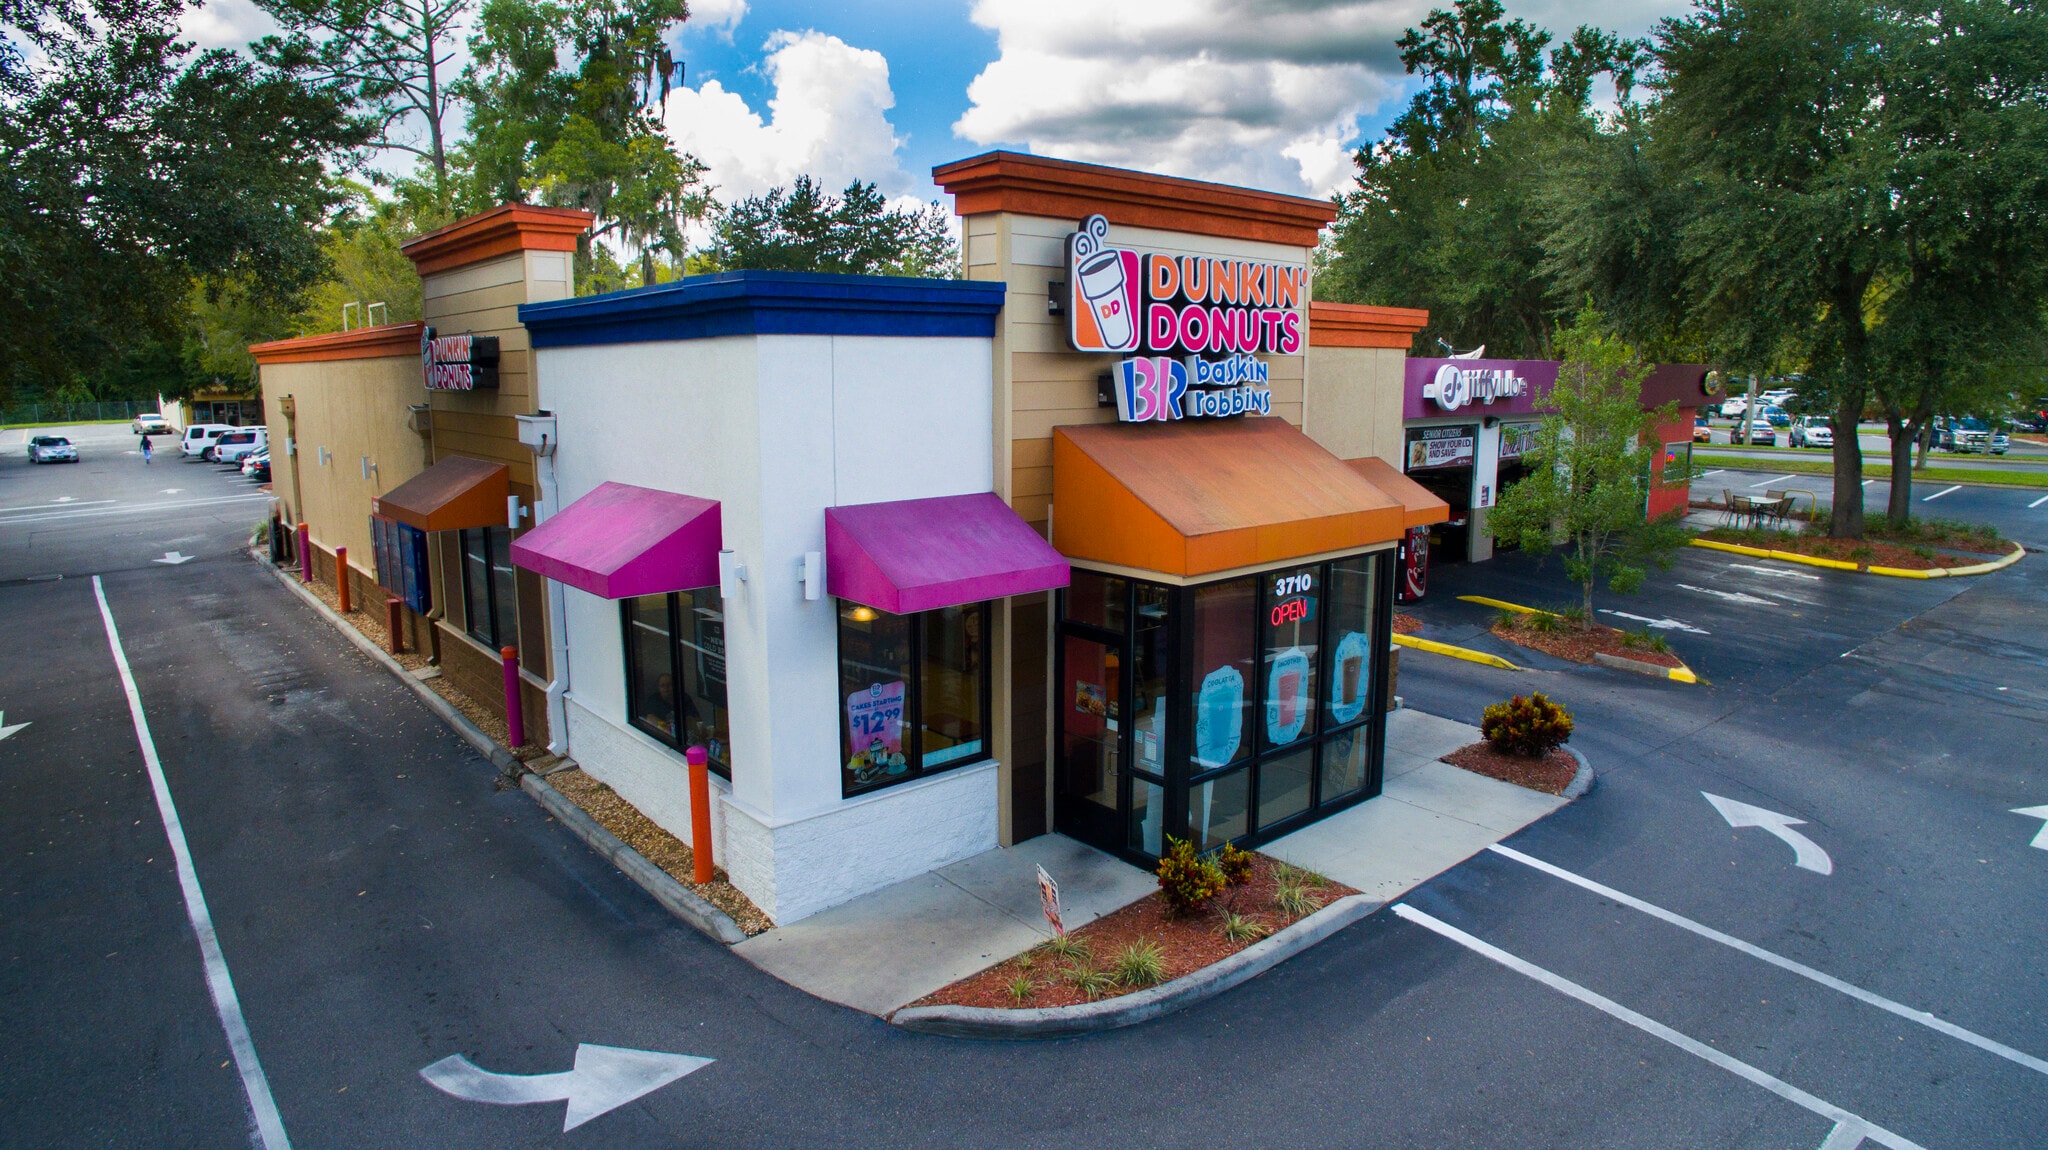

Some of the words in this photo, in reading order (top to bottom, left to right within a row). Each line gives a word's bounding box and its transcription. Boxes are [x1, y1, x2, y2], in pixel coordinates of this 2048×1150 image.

[1150, 254, 1308, 308] DUNKIN'
[1100, 300, 1120, 319] DD
[1149, 303, 1300, 353] DONUTS
[435, 363, 473, 390] DONUTS
[1194, 354, 1268, 386] baskin
[1121, 356, 1188, 421] BR
[1464, 369, 1497, 405] jiffy
[1497, 369, 1527, 397] lube
[1194, 387, 1271, 417] robbins
[1423, 430, 1441, 439] SENIOR
[1442, 428, 1462, 438] CITIZENS
[1429, 440, 1446, 449] SHOW
[1447, 440, 1461, 448] YOUR
[1429, 449, 1440, 458] AND
[1441, 449, 1456, 457] SAVE!
[1276, 573, 1311, 596] 3710
[1271, 599, 1307, 626] OPEN
[1207, 674, 1235, 687] COOLATTA
[851, 702, 872, 711] CAKES
[872, 695, 902, 707] STARTING
